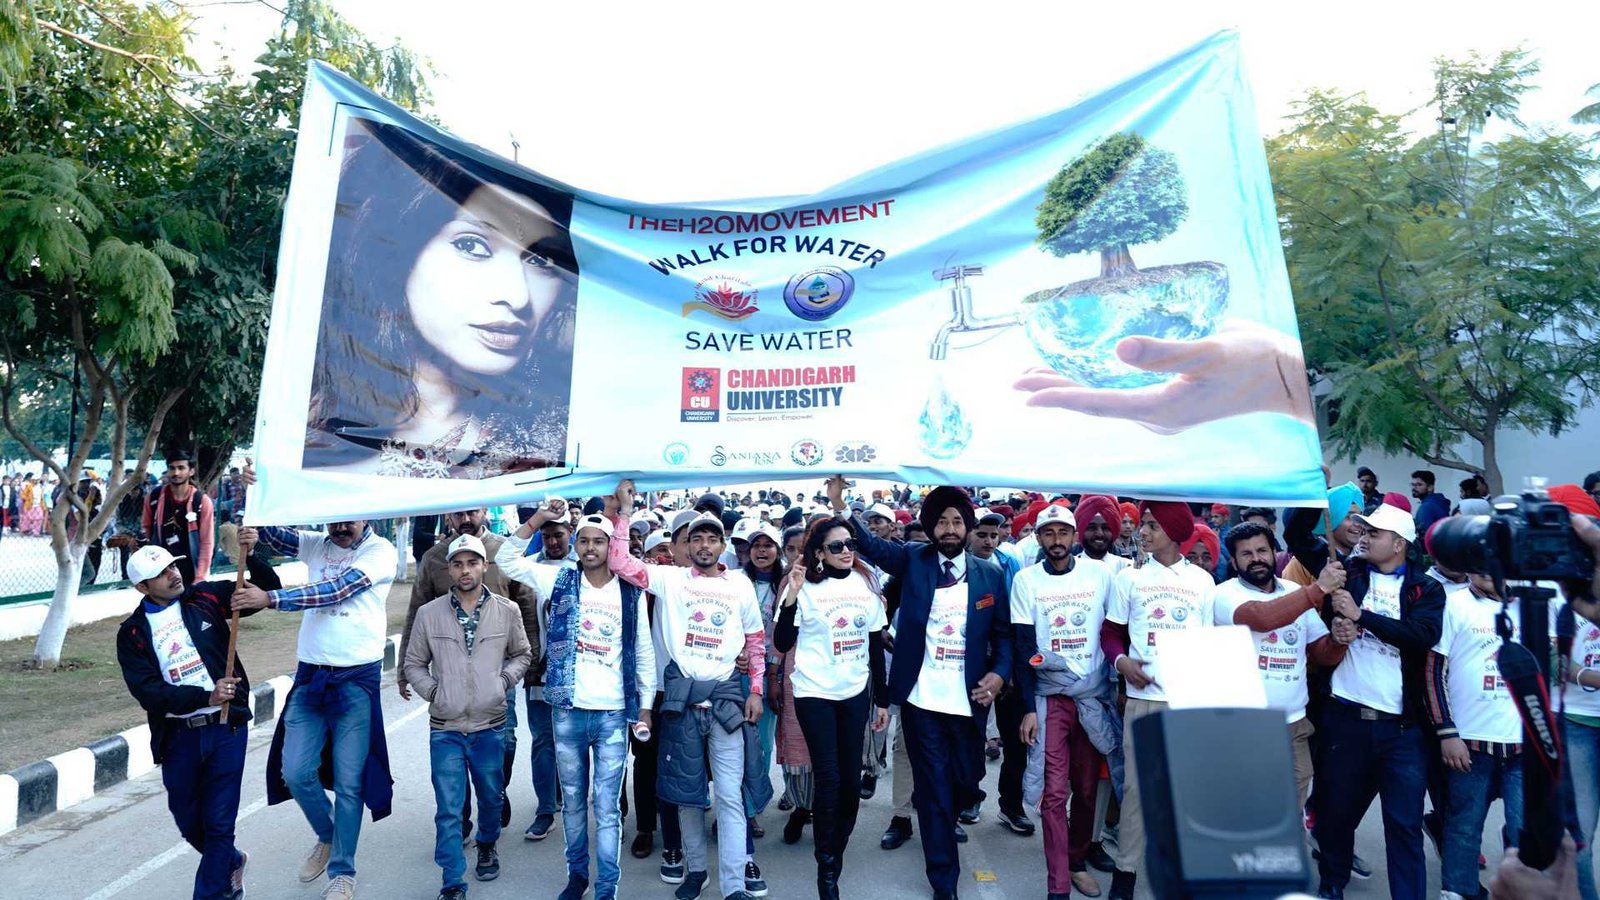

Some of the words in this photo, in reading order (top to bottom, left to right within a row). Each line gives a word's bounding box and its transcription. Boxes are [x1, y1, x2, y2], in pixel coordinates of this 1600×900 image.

[626, 199, 895, 235] THEH2OMOVEMENT
[648, 243, 730, 276] WALK
[733, 236, 787, 257] FOR
[794, 235, 887, 269] WATER
[685, 331, 754, 352] SAVE
[760, 328, 853, 351] WATER
[727, 365, 857, 388] CHANDIGARH
[690, 396, 711, 408] CU
[726, 387, 844, 410] UNIVERSITY
[688, 624, 703, 632] SAVE
[704, 627, 724, 635] WATER
[1523, 694, 1558, 760] Canon
